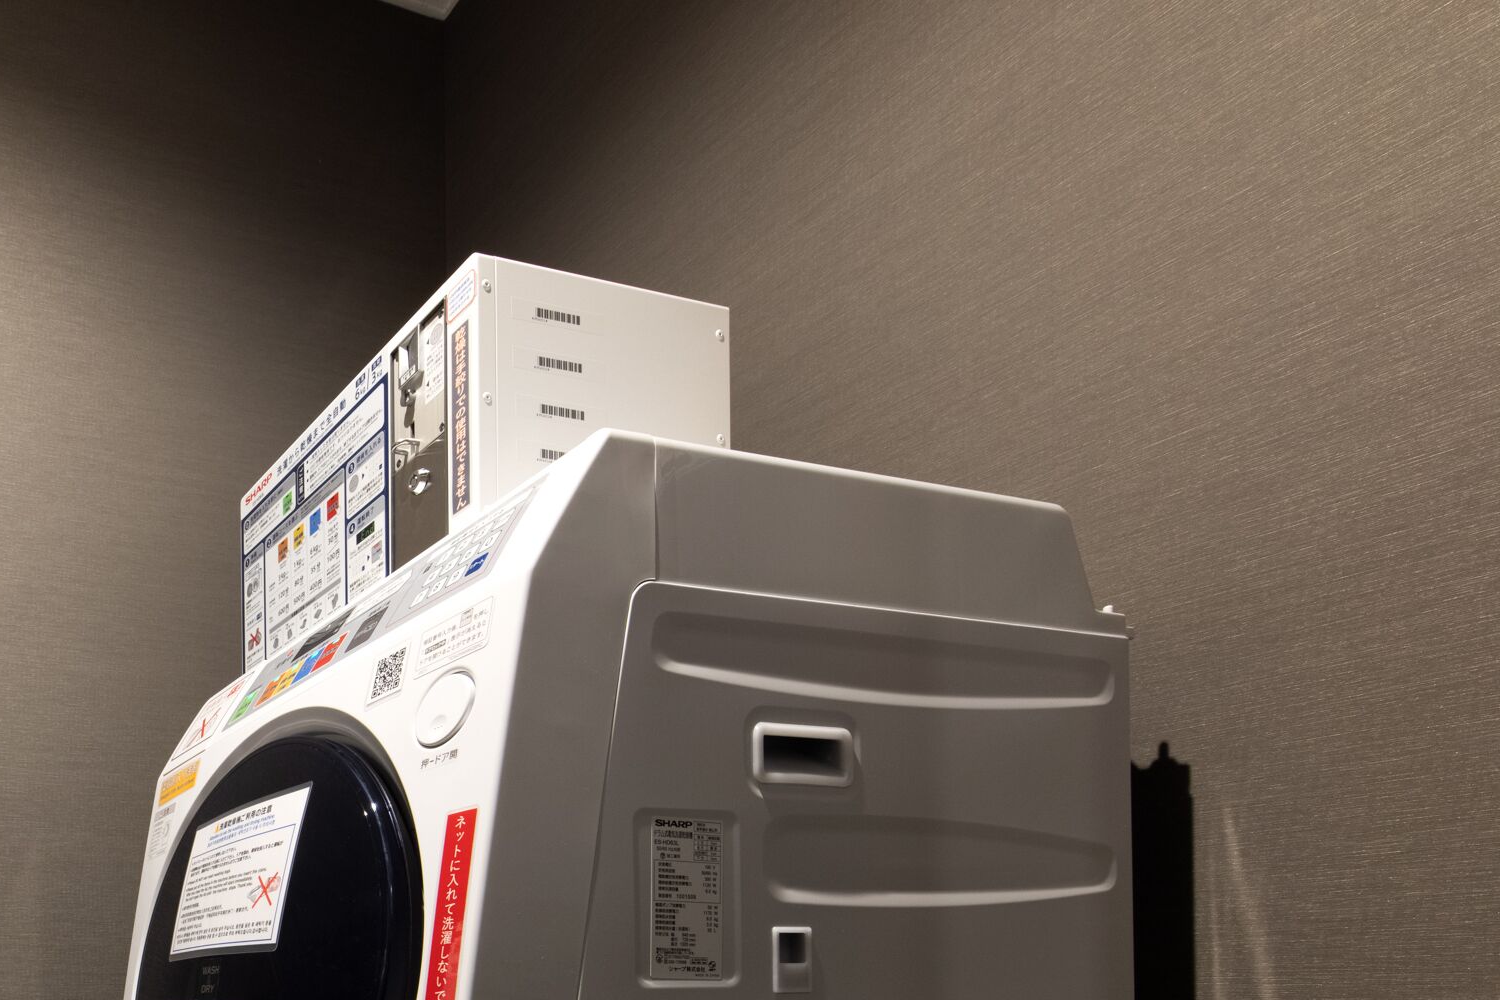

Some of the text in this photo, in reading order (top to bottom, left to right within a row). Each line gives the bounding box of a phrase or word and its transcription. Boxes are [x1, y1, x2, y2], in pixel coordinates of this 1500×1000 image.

[455, 325, 467, 511] 乾燥は手絞りでの使用はできません
[245, 473, 273, 505] SHARP
[220, 805, 272, 830] 洗濯乾燥機ご利用の注意
[655, 819, 693, 828] SHARP
[201, 984, 215, 993] DRY
